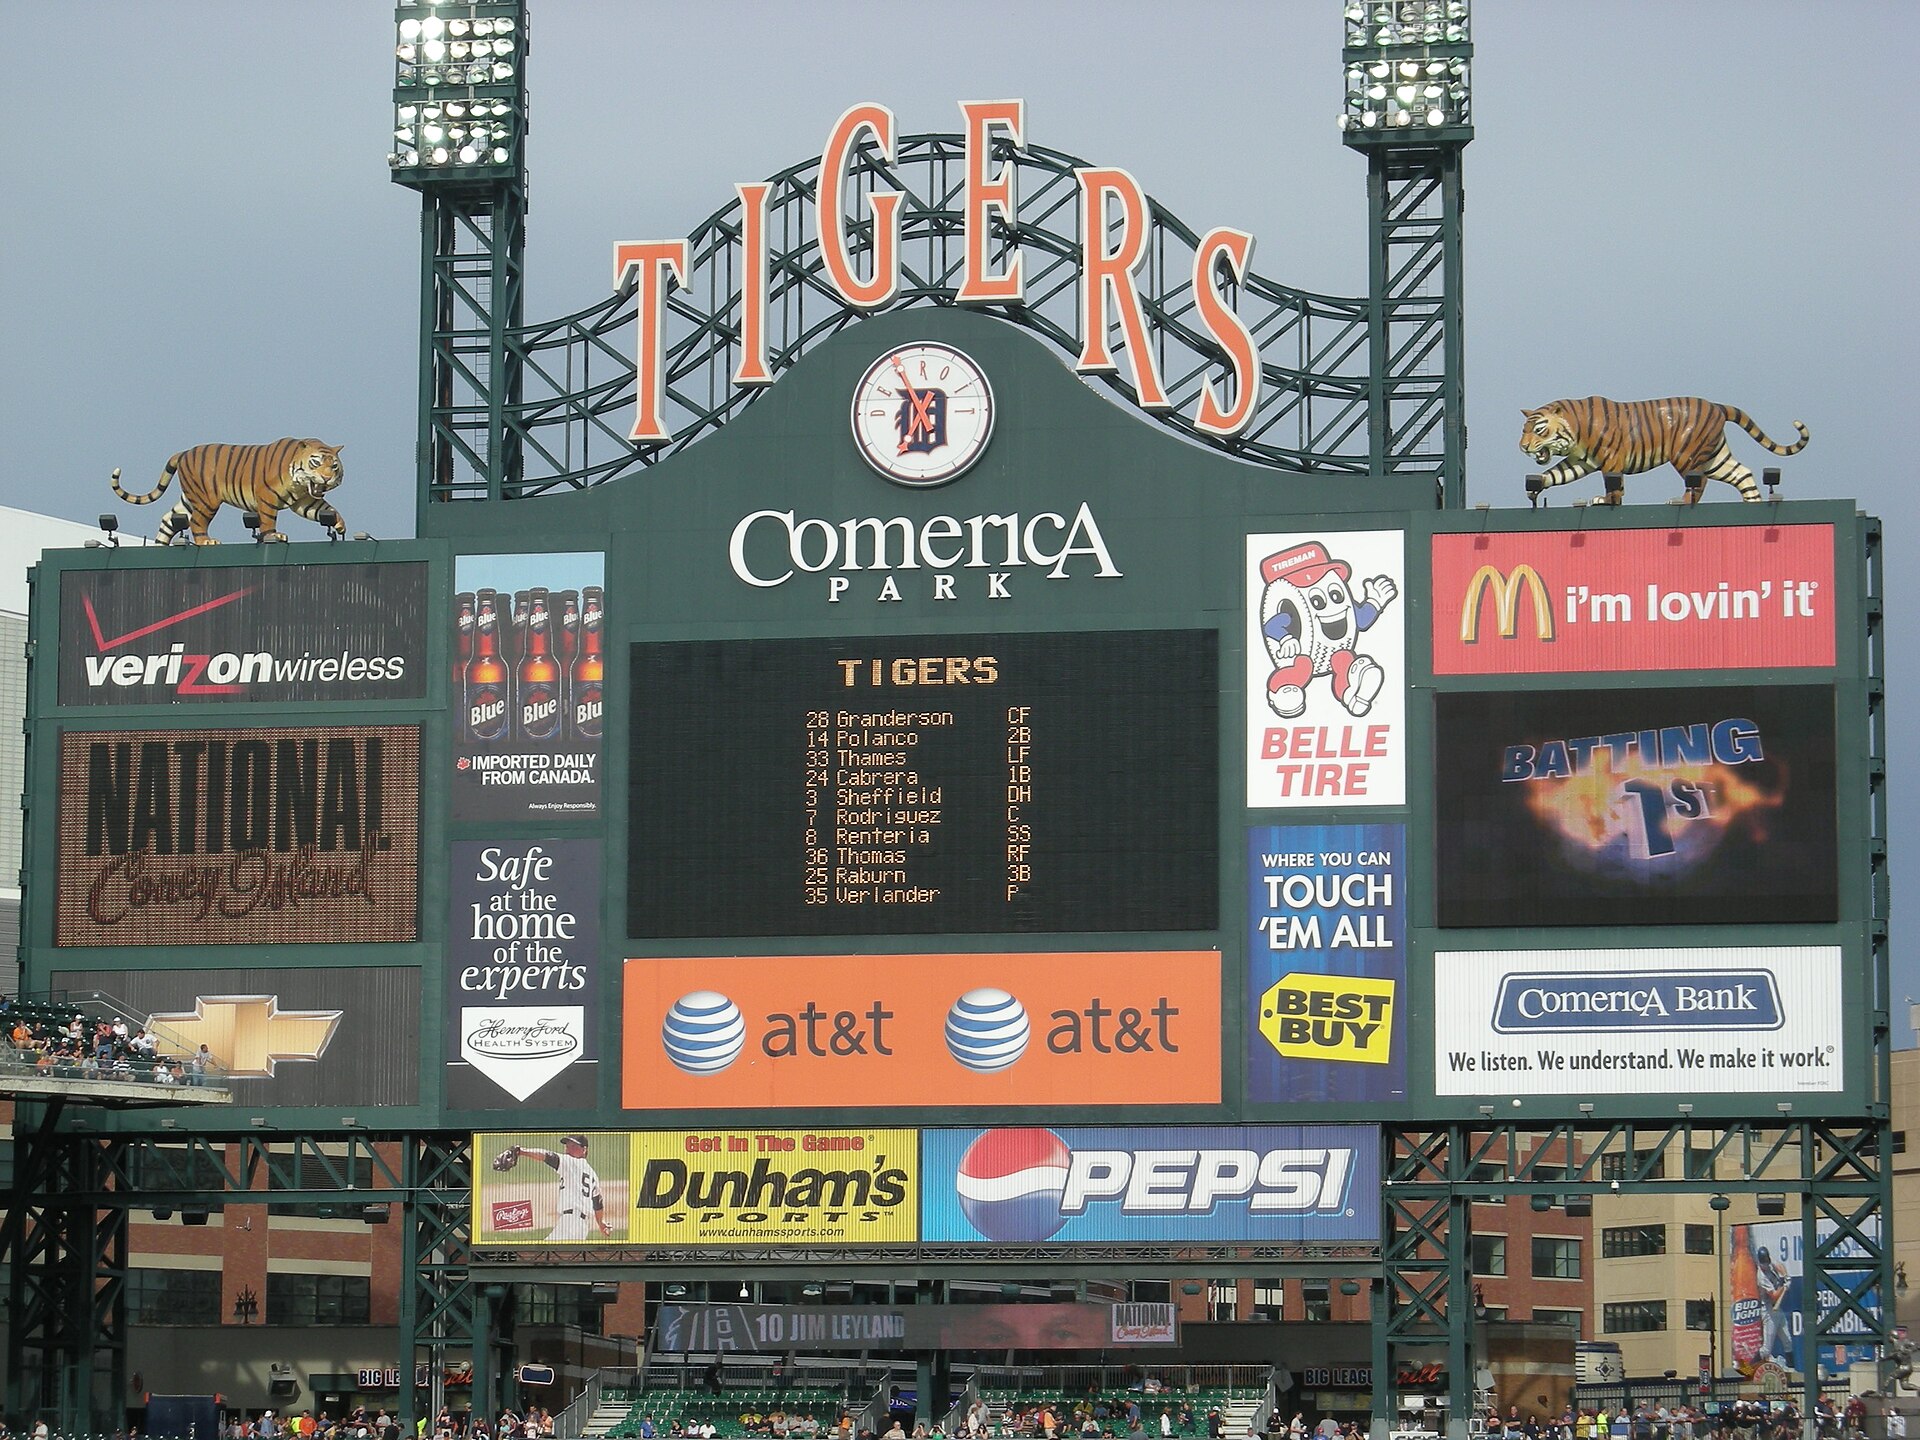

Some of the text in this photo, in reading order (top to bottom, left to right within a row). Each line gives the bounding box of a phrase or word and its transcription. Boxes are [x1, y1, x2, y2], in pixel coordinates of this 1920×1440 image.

[612, 98, 1258, 443] TIGERS
[1271, 550, 1316, 573] TIREMAN
[828, 572, 1012, 602] PARK
[1566, 581, 1815, 623] i'm lovin' it
[478, 611, 497, 627] Blue
[513, 613, 528, 626] lue
[530, 610, 549, 626] Blue
[584, 609, 603, 625] Blue
[85, 642, 406, 694] verizon wireless
[837, 656, 999, 687] TIGERS
[471, 699, 505, 726] Blue
[523, 699, 557, 725] Blue
[577, 701, 603, 724] Blu
[806, 707, 1031, 728] 28 Granderson CF
[807, 727, 1031, 748] 14 Polanco 2B
[1261, 725, 1390, 759] BELLE
[472, 753, 596, 770] IMPORTED DAILY
[806, 747, 1031, 767] 33 Thames LF
[1502, 717, 1764, 783] BATTING
[482, 770, 595, 785] FROM CANADA.
[806, 766, 1031, 786] 24 Cabrera 1B
[1276, 763, 1370, 797] TIRE
[806, 786, 1031, 806] 3 Sheffield DH
[806, 806, 1020, 826] 7 Rodriguez C
[805, 825, 1031, 845] 8 Renteria SS
[805, 845, 1031, 865] 36 Thomas RF
[1262, 851, 1391, 867] WHERE YOU CAN
[476, 846, 553, 890] Safe
[805, 865, 1031, 884] 25 Raburn 3B
[489, 889, 557, 912] at the
[805, 885, 1019, 904] 35 Verlander P
[1263, 873, 1392, 909] TOUCH
[470, 903, 576, 940] home
[1258, 915, 1393, 949] 'EM ALL
[493, 940, 562, 963] of the
[460, 959, 587, 1000] experts
[1277, 988, 1391, 1022] BEST
[1676, 983, 1757, 1012] Bank
[479, 1018, 570, 1041] Henry Ford
[761, 1001, 894, 1057] at&t
[1046, 997, 1179, 1054] at&t
[1279, 1017, 1380, 1049] BUY
[474, 1038, 573, 1047] HEALTH SYSTEM
[1449, 1047, 1830, 1071] We listen. We understand. We make it work.
[685, 1134, 864, 1152] Get In The Game
[636, 1155, 909, 1209] Dunham's
[1060, 1148, 1352, 1213] PEPSI
[666, 1212, 881, 1223] SPORTS
[699, 1226, 845, 1239] www.dunhamssports.com
[1780, 1236, 1789, 1262] 9
[1733, 1308, 1761, 1320] LIGHT
[1734, 1300, 1758, 1312] BUD
[756, 1313, 905, 1342] 10 JIM LEYLAND
[359, 1368, 382, 1386] BIG
[1304, 1367, 1329, 1386] BIG
